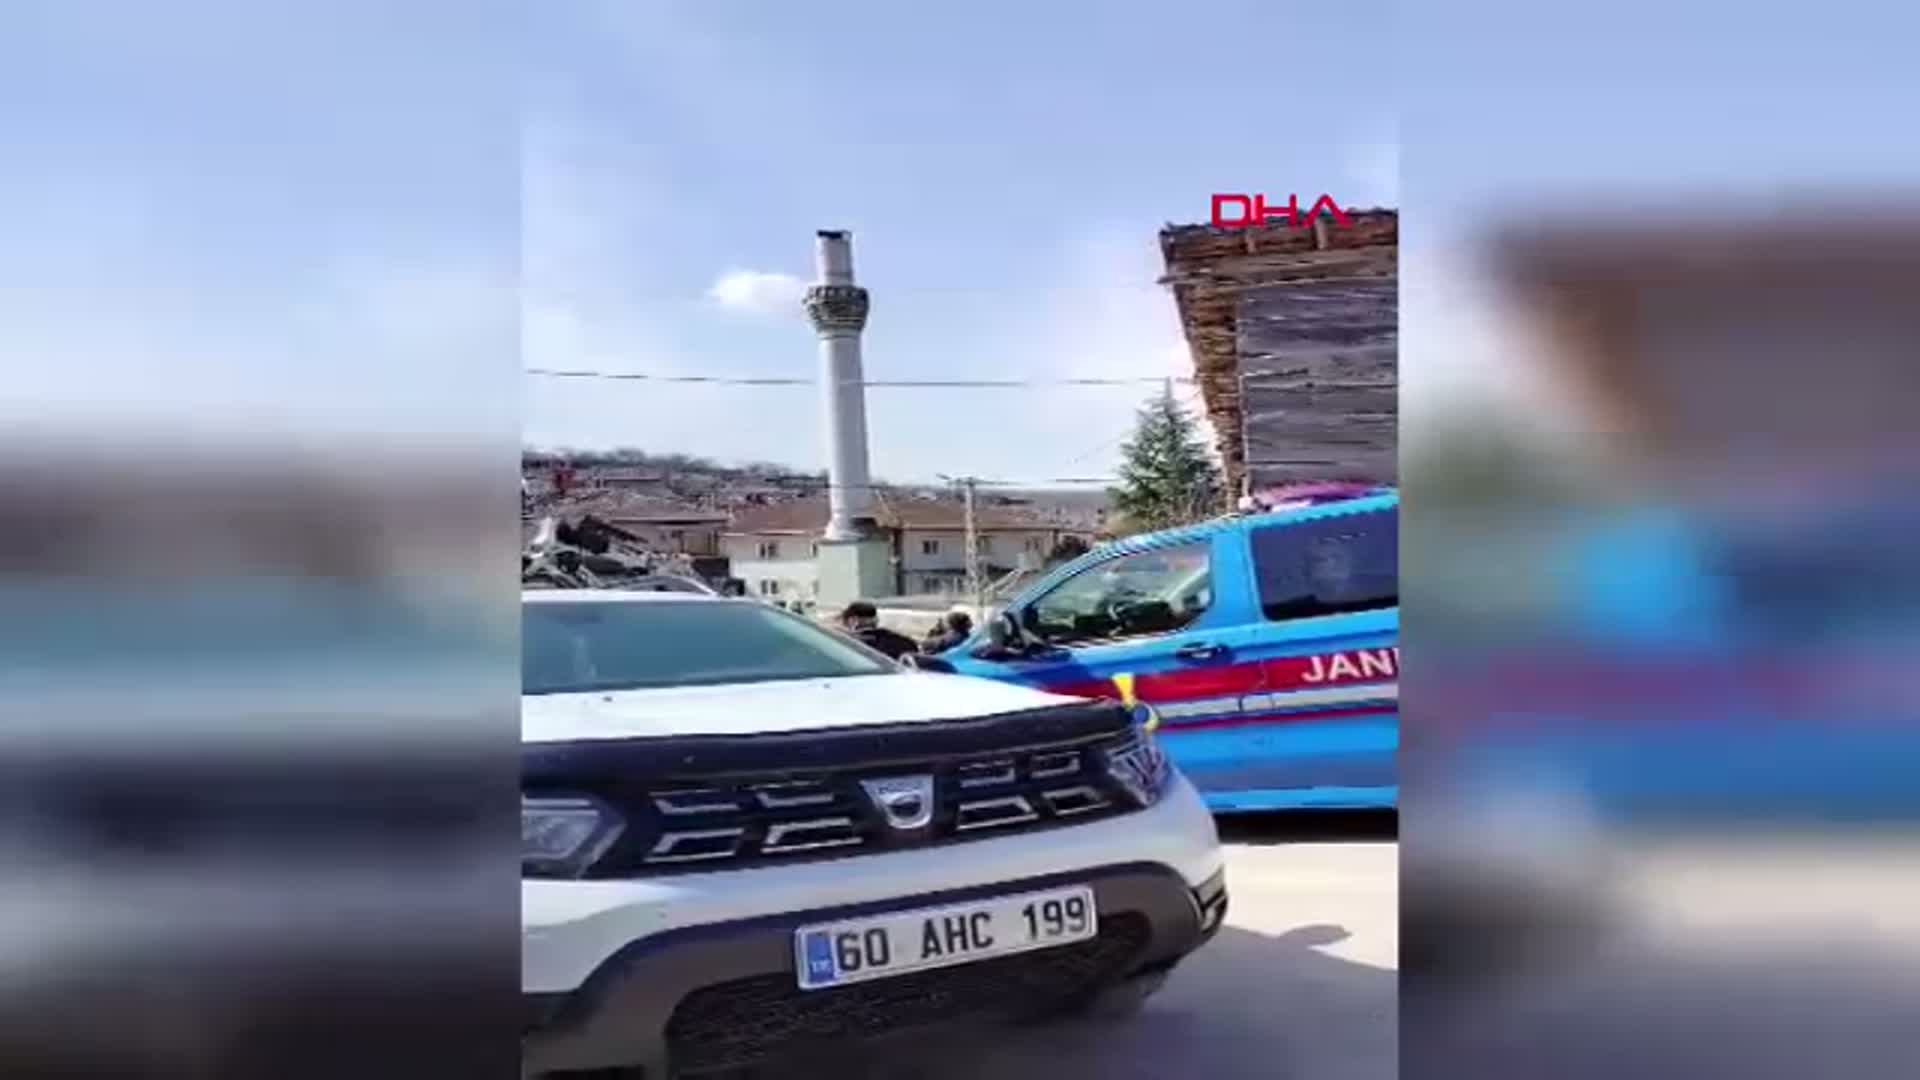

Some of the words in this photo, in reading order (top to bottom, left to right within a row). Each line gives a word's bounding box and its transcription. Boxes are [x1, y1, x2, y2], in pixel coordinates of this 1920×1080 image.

[1301, 648, 1399, 682] JAN
[836, 927, 890, 971] 60
[920, 911, 994, 959] AHC
[1022, 896, 1085, 941] 199
